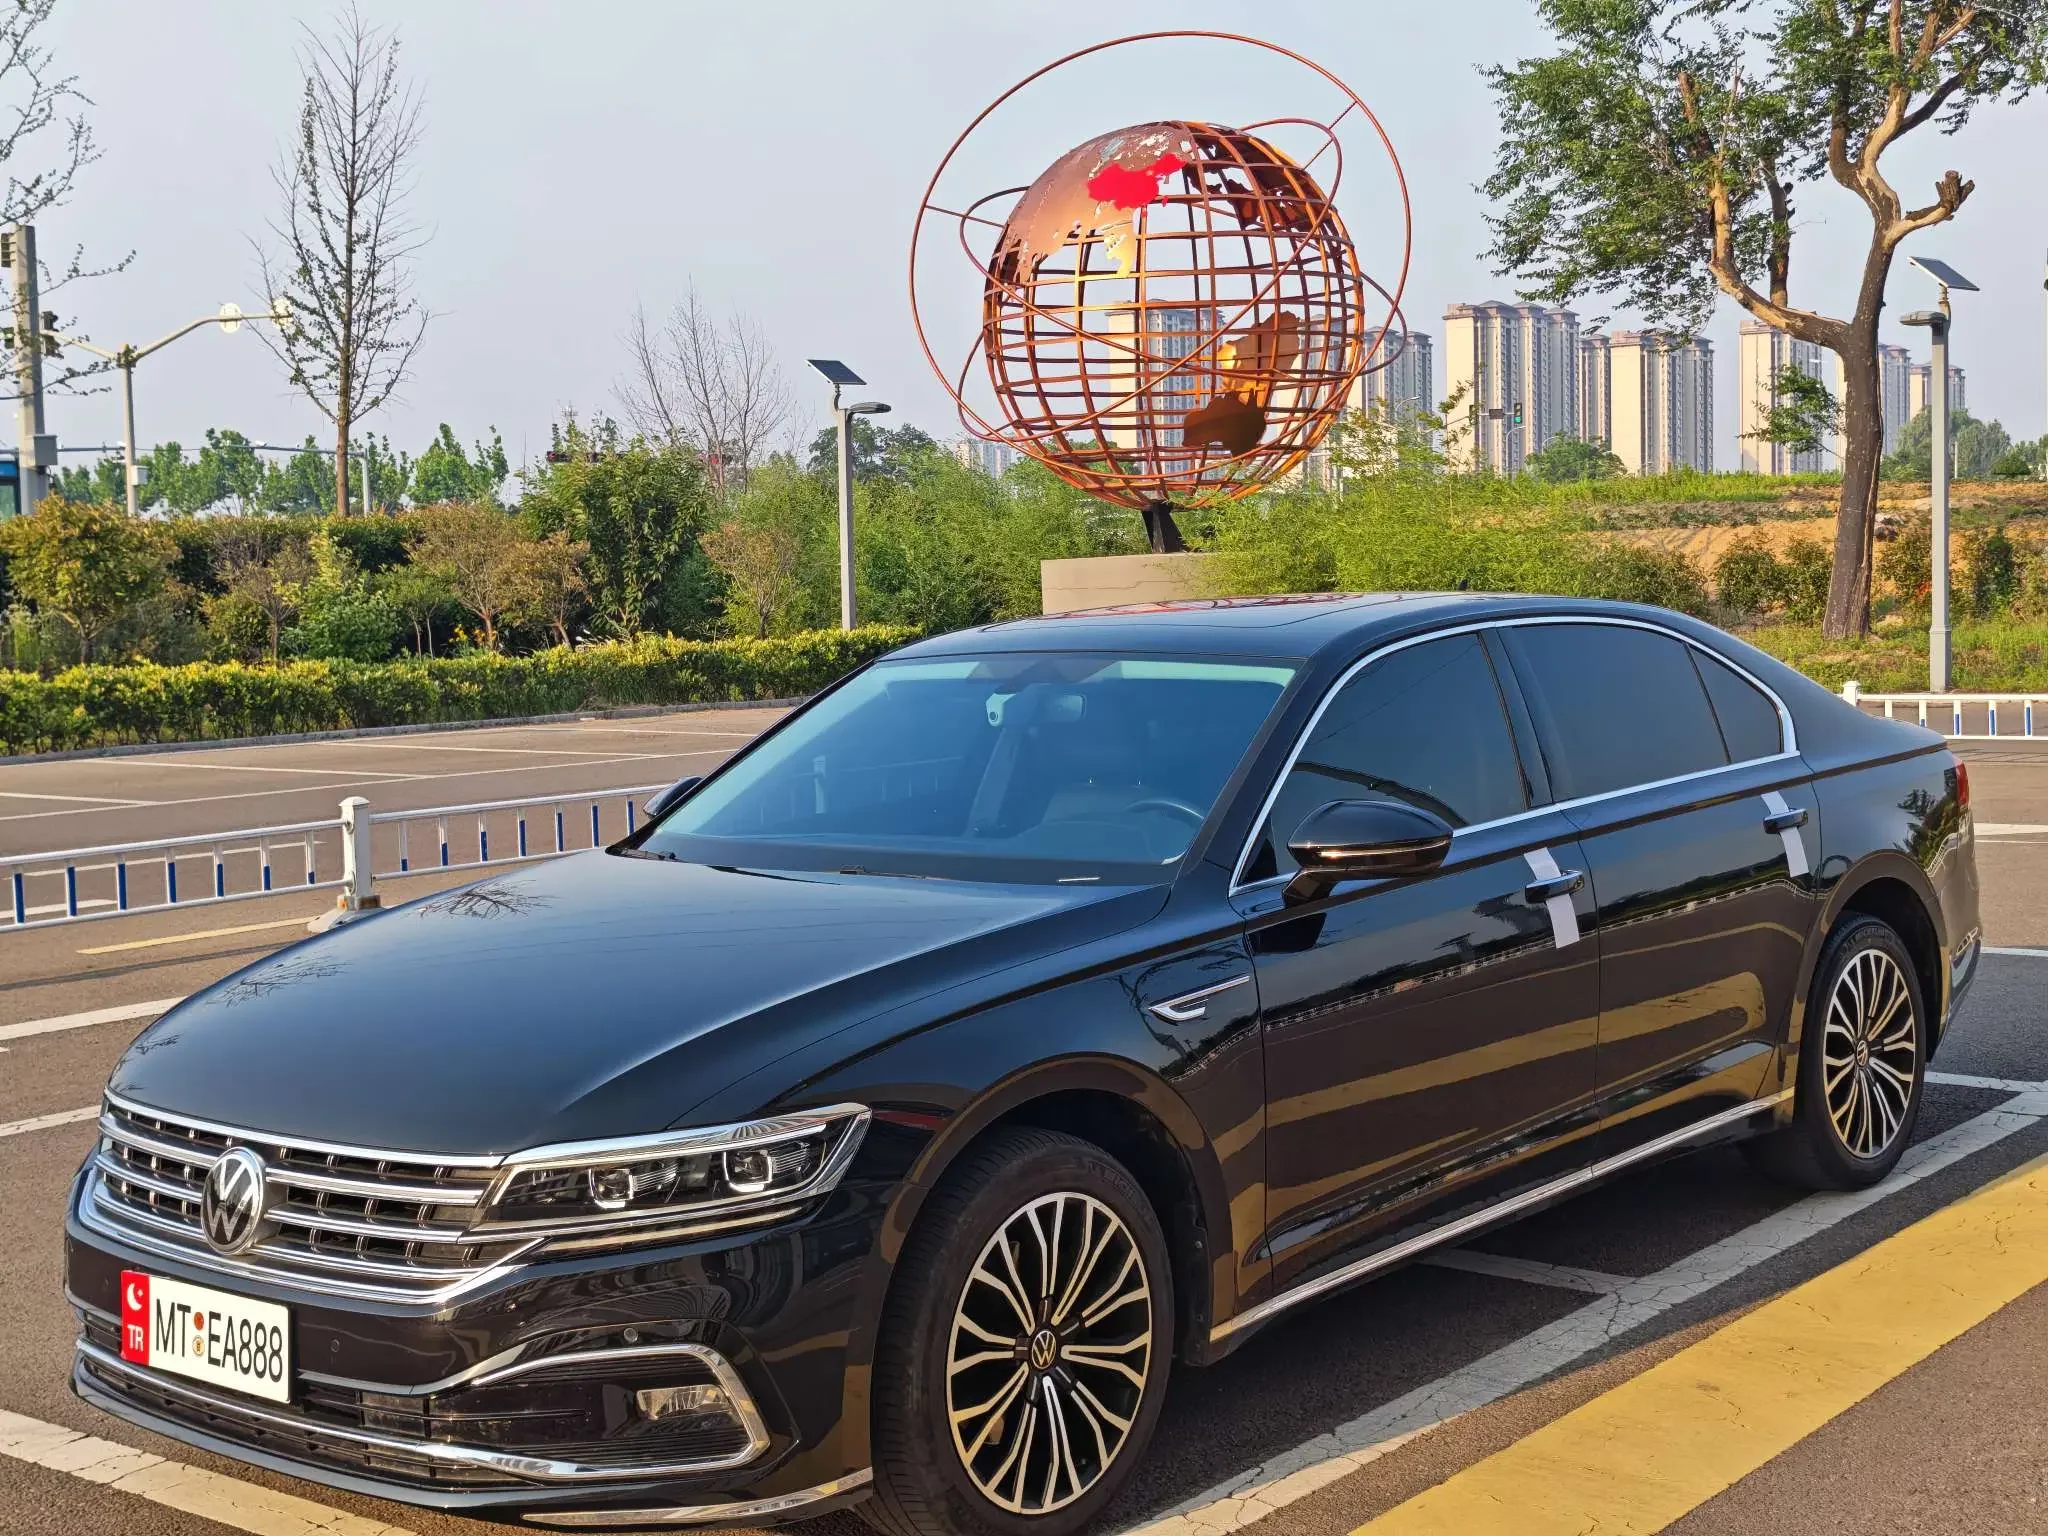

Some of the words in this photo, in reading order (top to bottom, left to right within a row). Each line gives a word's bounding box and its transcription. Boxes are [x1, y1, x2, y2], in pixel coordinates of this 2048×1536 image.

[127, 1324, 144, 1352] TR
[155, 1298, 191, 1358] MT
[207, 1310, 283, 1383] EA888
